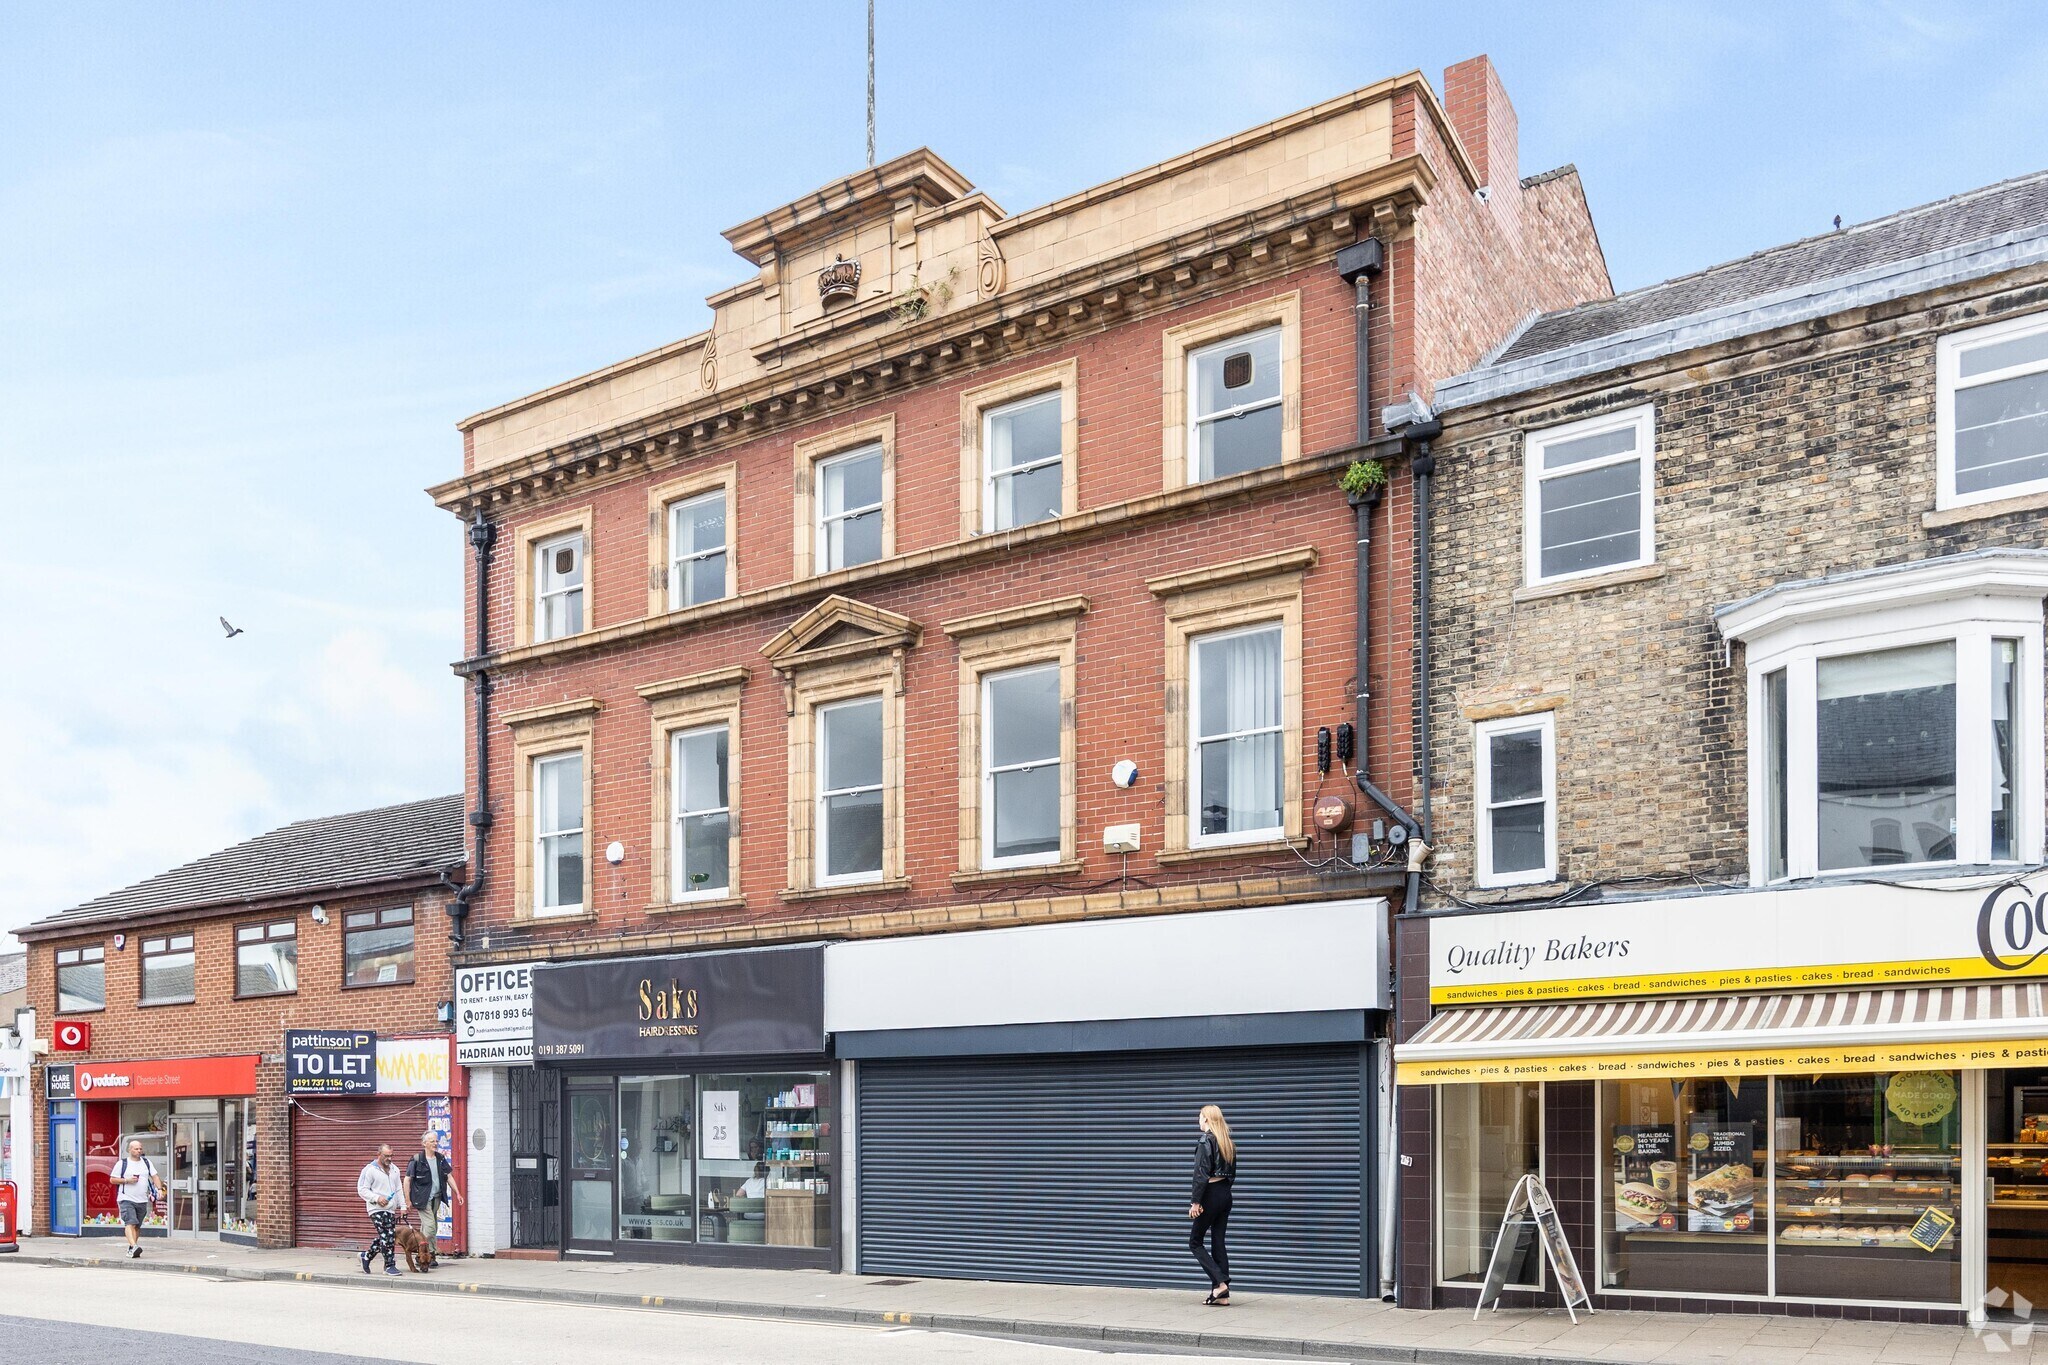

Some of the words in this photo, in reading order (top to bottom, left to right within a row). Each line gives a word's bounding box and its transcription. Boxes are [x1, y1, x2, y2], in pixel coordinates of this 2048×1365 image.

[1447, 941, 1535, 973] Quality
[1544, 935, 1630, 961] Bakers
[1447, 989, 1498, 1000] sandwiches
[1506, 988, 1524, 998] pies
[1527, 986, 1534, 994] &
[1536, 984, 1569, 996] pasties
[1578, 983, 1604, 992] cakes
[1614, 981, 1640, 990] bread
[1649, 978, 1707, 988] sandwiches
[1719, 976, 1740, 986] pies
[1744, 975, 1751, 984] &
[1755, 973, 1792, 984] pasties
[1802, 970, 1833, 981] cakes
[1843, 969, 1874, 979] bread
[1884, 965, 1950, 977] sandwiches
[639, 978, 698, 1020] Saks
[475, 1010, 500, 1021] 07818
[503, 1009, 519, 1018] 993
[640, 1025, 698, 1037] HAIRDRESSING
[293, 1035, 351, 1048] pattinson
[538, 1045, 553, 1054] 0191
[556, 1045, 567, 1054] 387
[569, 1044, 584, 1053] 5091
[460, 1047, 504, 1059] HADRIAN
[293, 1054, 323, 1074] TO
[329, 1054, 370, 1074] LET
[1420, 1067, 1470, 1076] sandwiches
[1480, 1066, 1499, 1076] pies
[1514, 1065, 1548, 1075] pasties
[1559, 1063, 1587, 1072] cakes
[1598, 1062, 1626, 1071] bread
[1637, 1060, 1695, 1070] sandwiches
[1707, 1059, 1728, 1069] pies
[1734, 1058, 1741, 1066] &
[1746, 1056, 1784, 1067] pasties
[1798, 1054, 1830, 1064] cakes
[1843, 1053, 1875, 1063] bread
[1889, 1050, 1956, 1062] sandwiches
[1971, 1049, 1995, 1060] pies
[2002, 1048, 2010, 1058] &
[2016, 1047, 2048, 1059] pasti
[93, 1073, 130, 1087] vodafone
[136, 1074, 181, 1085] Chester-le-Street
[1895, 1071, 1948, 1088] COOPLANDS
[1896, 1103, 1910, 1116] 140
[1913, 1103, 1944, 1119] YEARS
[713, 1126, 727, 1140] 25
